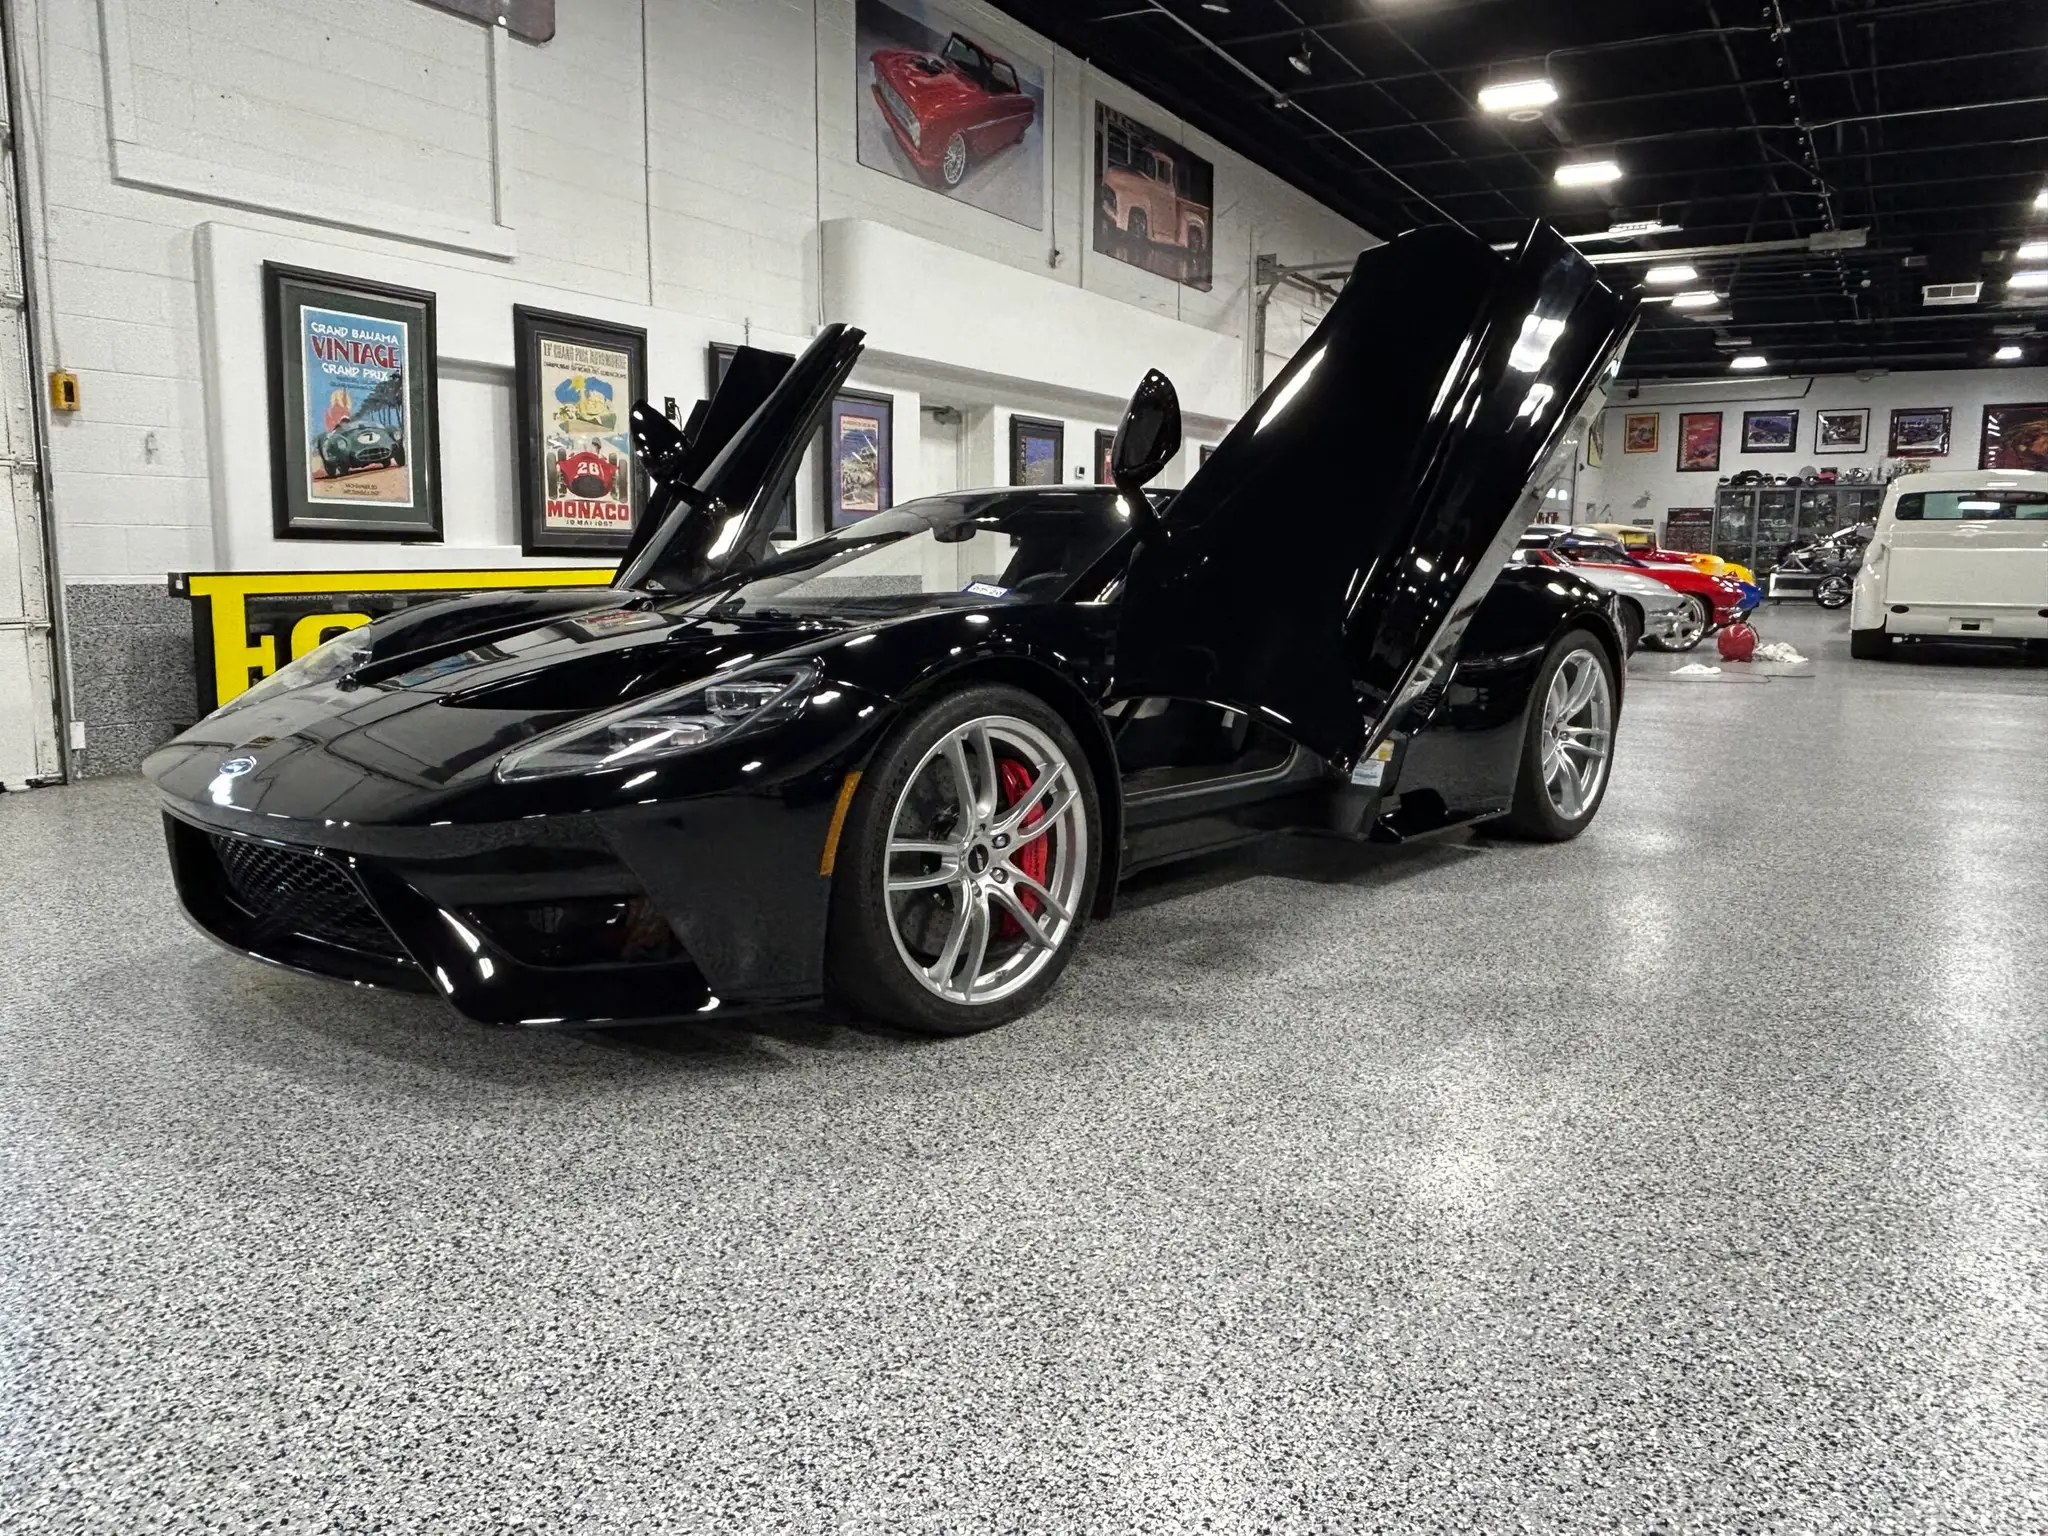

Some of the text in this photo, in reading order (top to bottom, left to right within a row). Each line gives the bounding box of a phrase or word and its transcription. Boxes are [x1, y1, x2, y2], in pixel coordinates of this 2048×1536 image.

[311, 321, 399, 346] GRAND BAHAMA
[310, 334, 400, 369] VINTAGE
[322, 362, 389, 382] GRAND PRIX
[547, 500, 630, 521] MONACO
